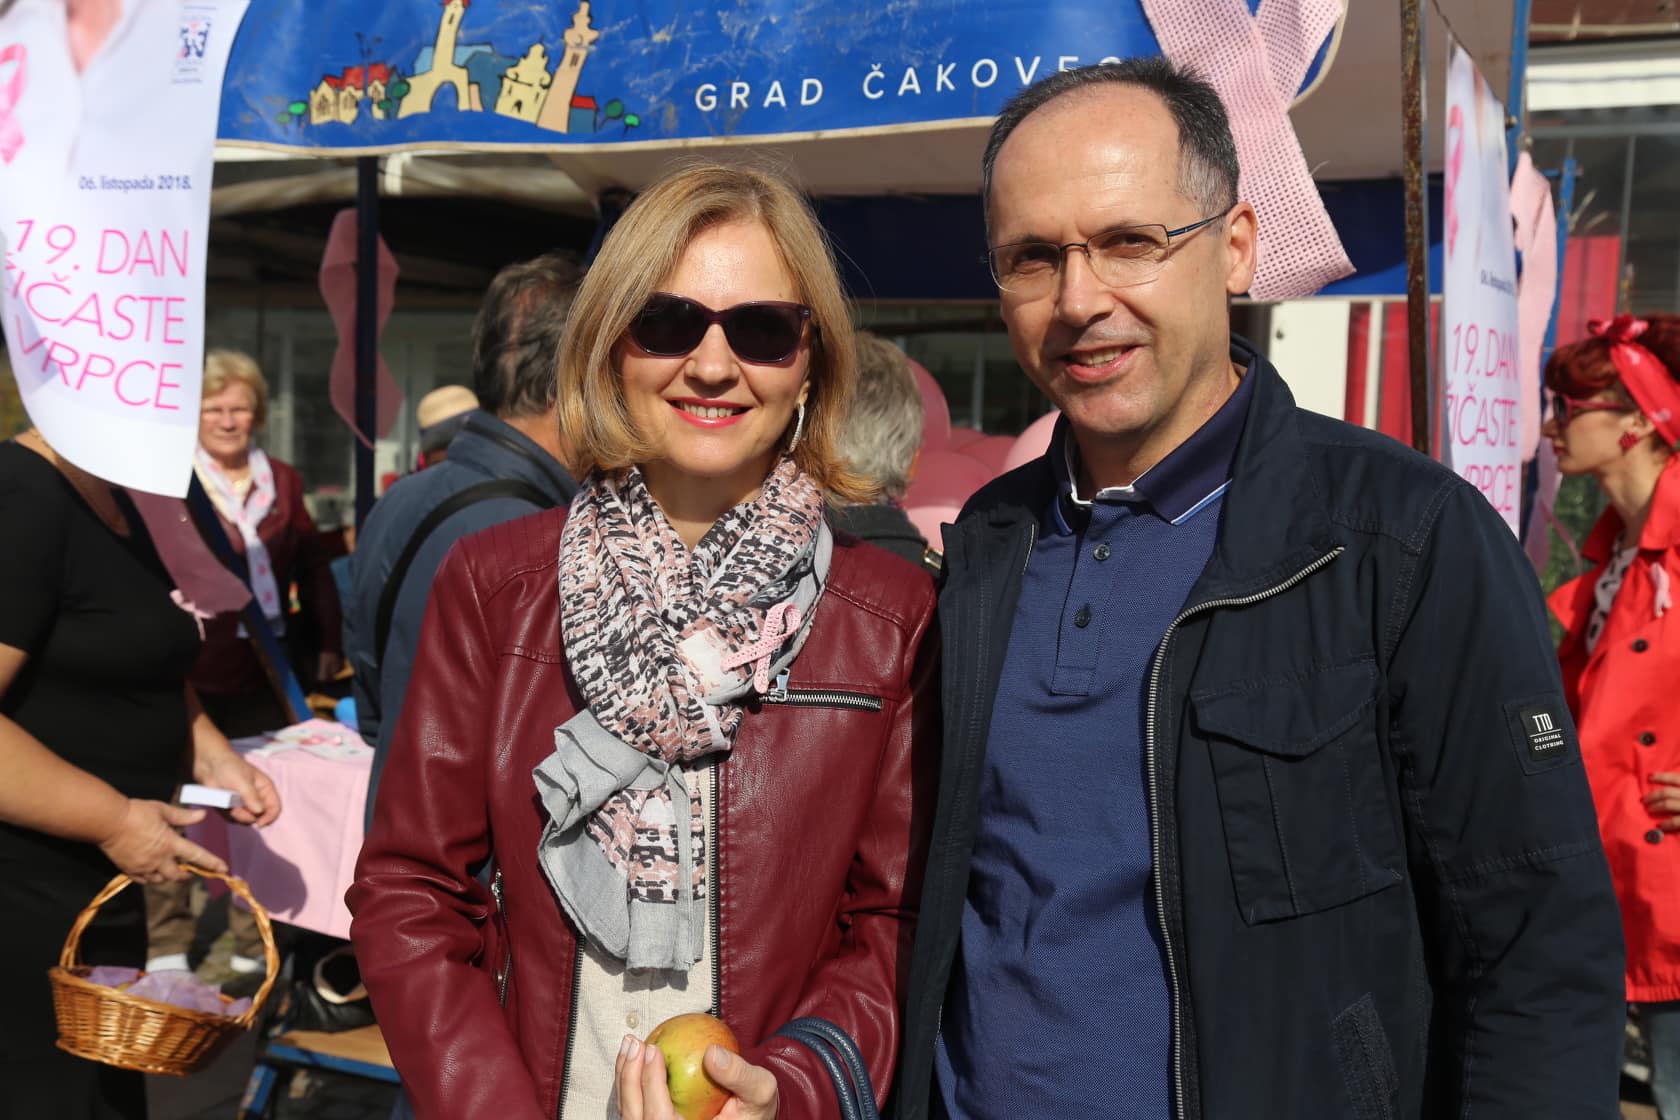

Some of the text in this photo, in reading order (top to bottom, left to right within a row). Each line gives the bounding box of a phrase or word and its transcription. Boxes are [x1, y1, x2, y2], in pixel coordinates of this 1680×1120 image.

[695, 55, 1122, 111] GRAD ČAKOVE
[101, 175, 155, 194] listopada
[15, 219, 189, 278] 19. DAN
[14, 314, 184, 411] VRPCE
[1453, 323, 1518, 382] 19. DAN
[1534, 733, 1562, 743] ORIGINAL
[1534, 740, 1564, 750] CLOTHING
